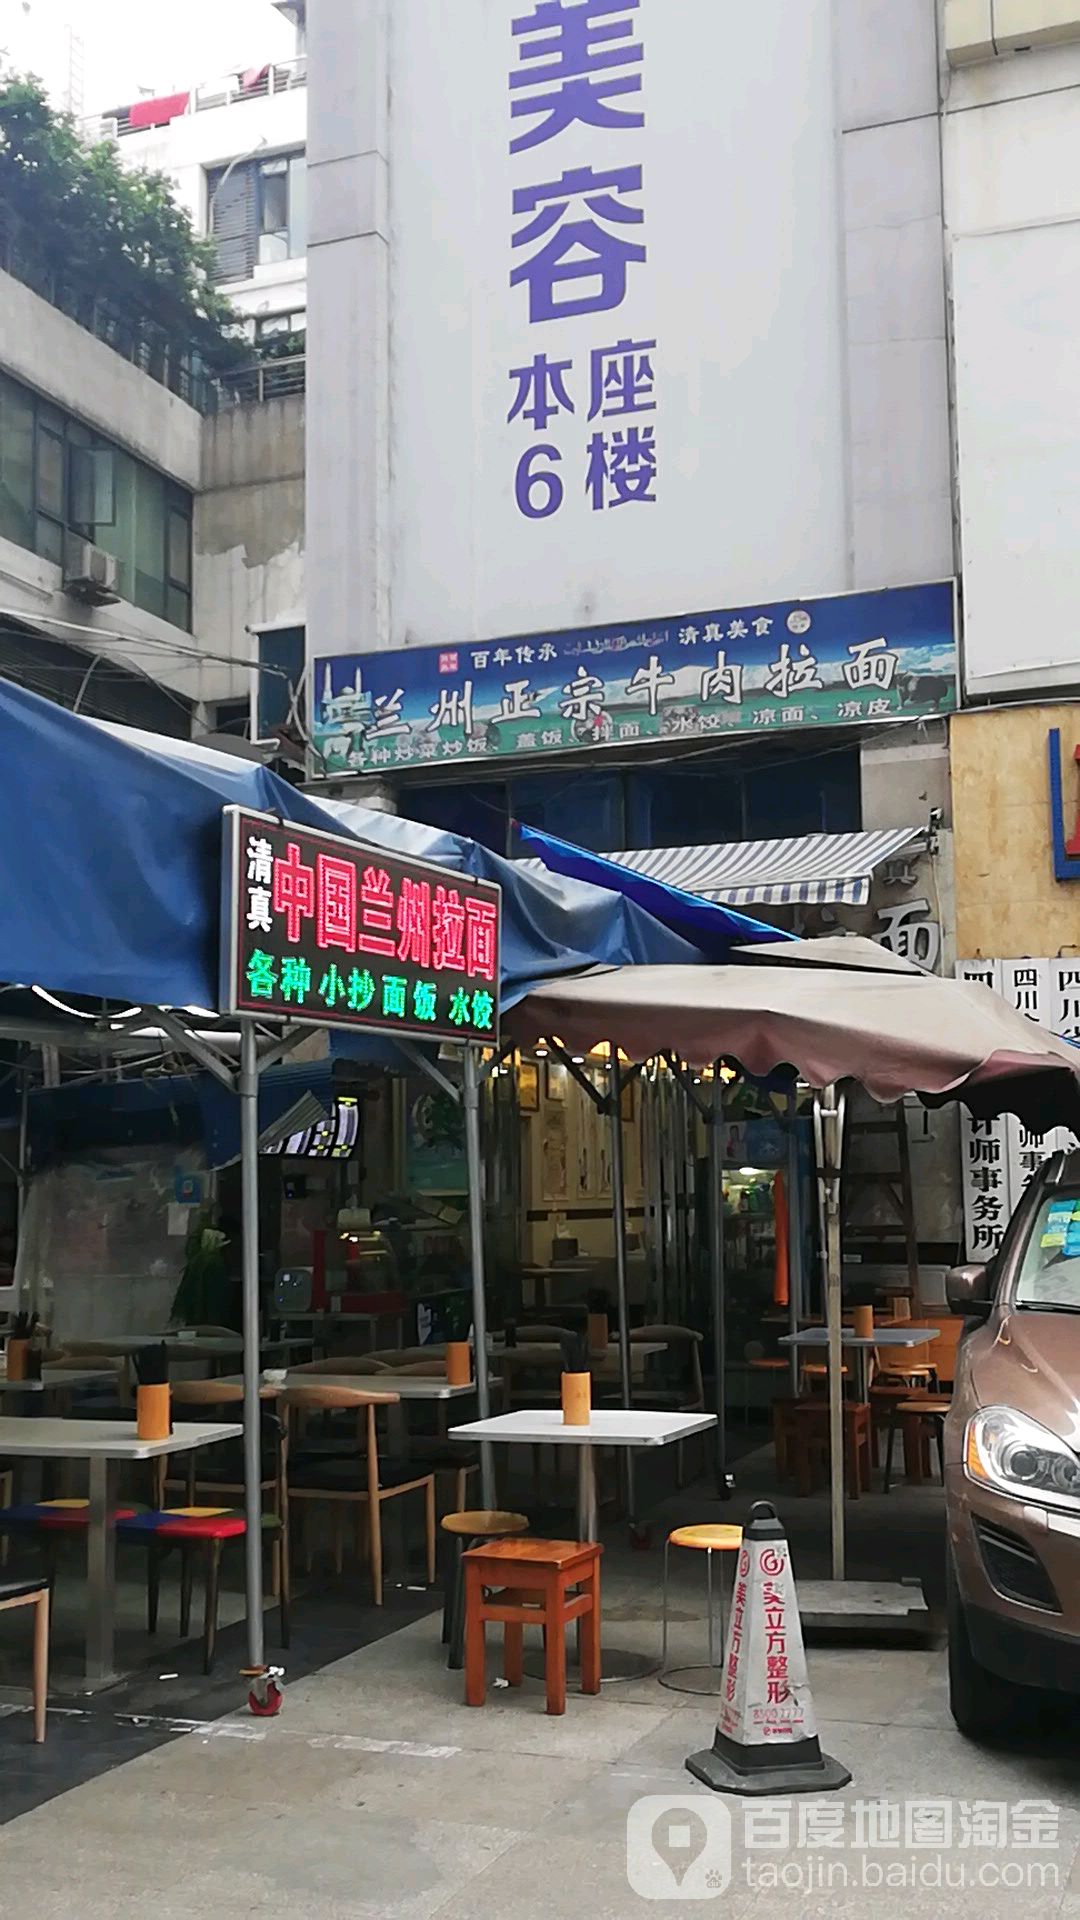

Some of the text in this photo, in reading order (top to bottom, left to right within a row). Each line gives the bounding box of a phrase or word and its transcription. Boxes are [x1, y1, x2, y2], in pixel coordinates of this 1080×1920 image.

[509, 0, 646, 324] 美容
[507, 339, 657, 430] 本座
[515, 427, 657, 519] 6楼
[366, 637, 898, 741] 兰州正宗牛肉拉面
[470, 643, 558, 669] 百年传承
[678, 616, 773, 645] 清真美食
[246, 836, 273, 933] 清真
[273, 842, 497, 982] 中国兰州拉面
